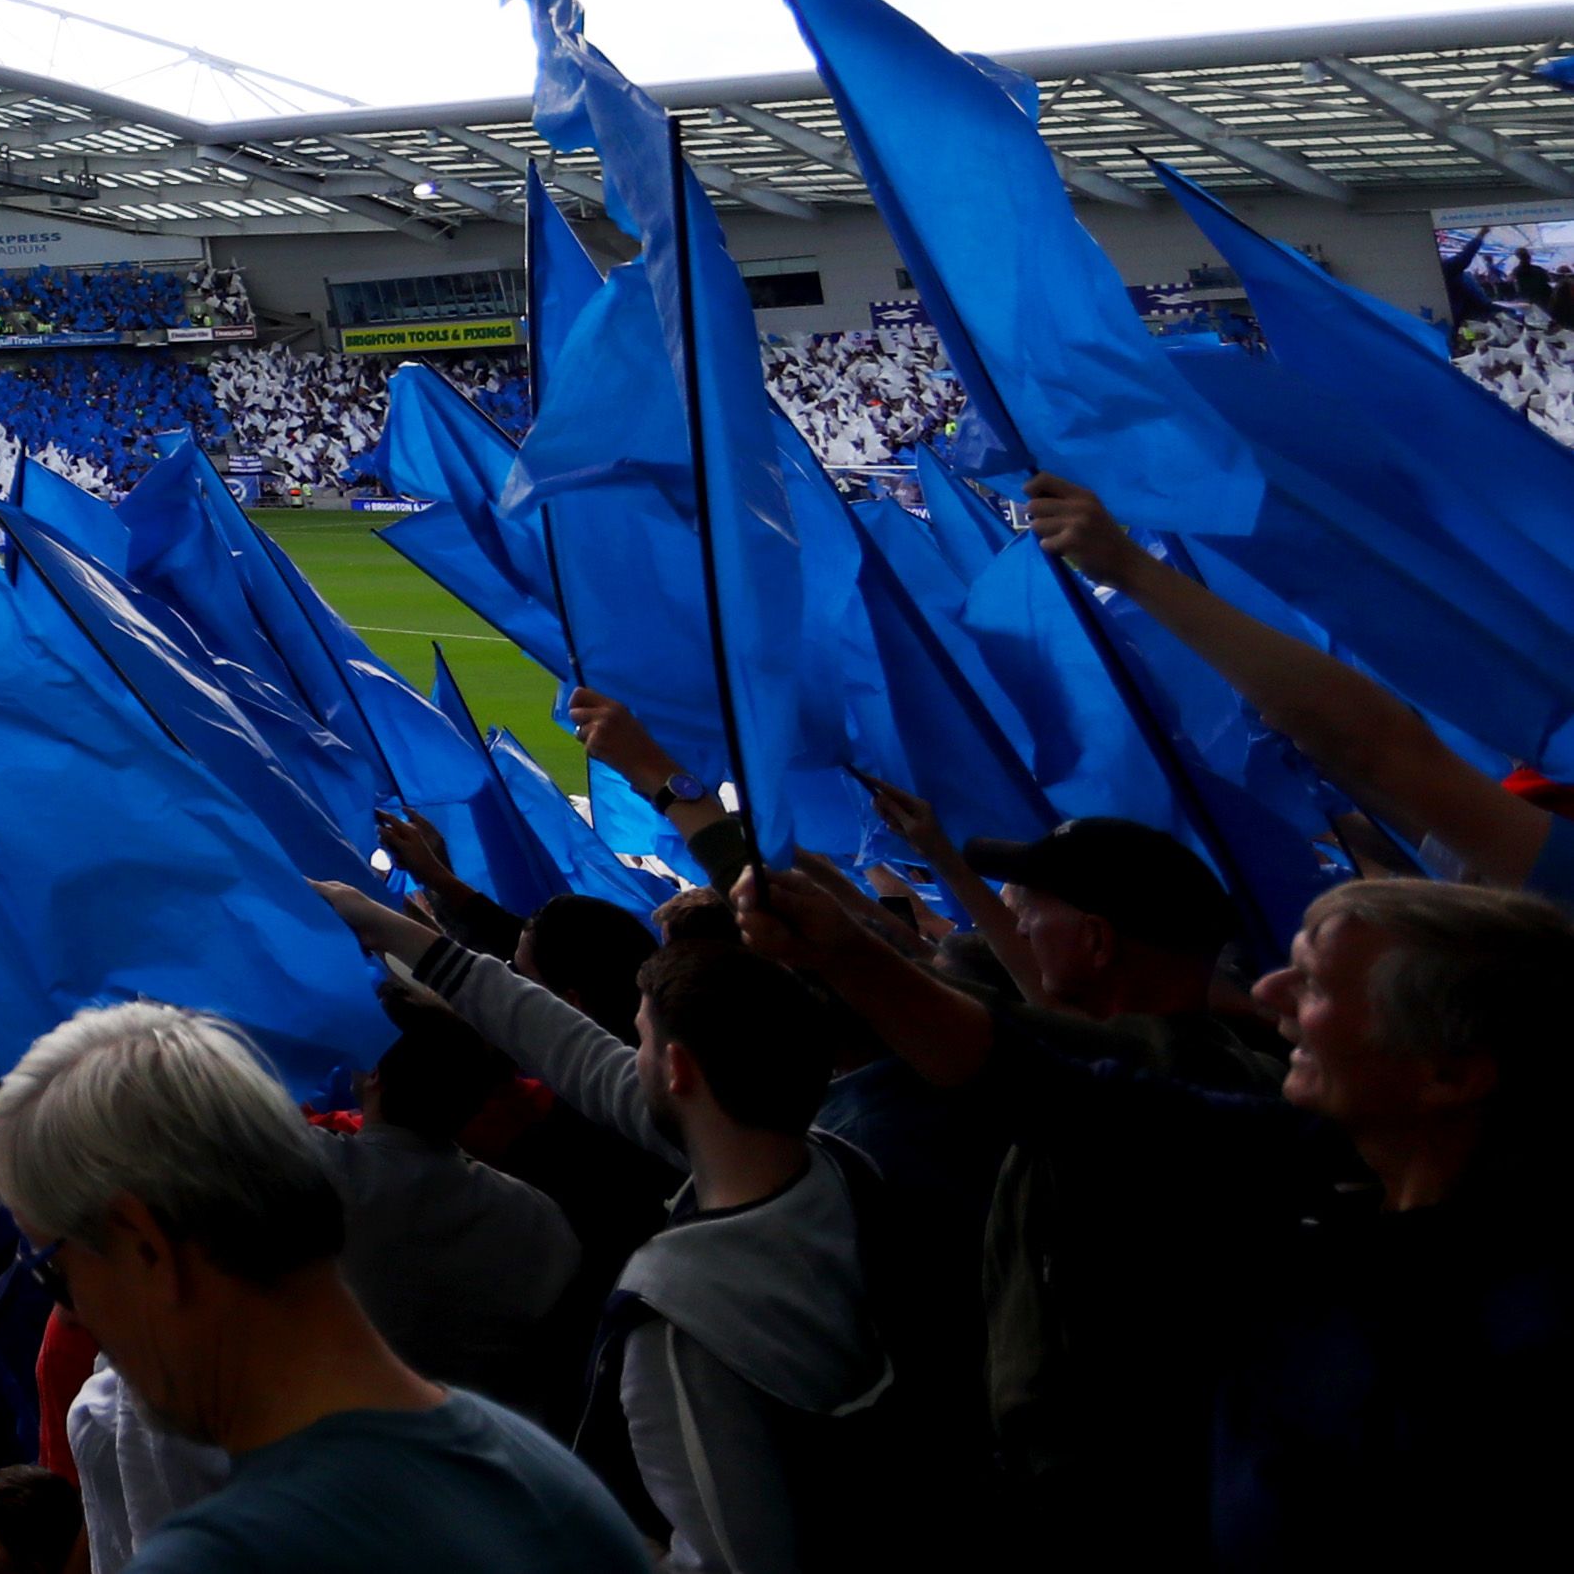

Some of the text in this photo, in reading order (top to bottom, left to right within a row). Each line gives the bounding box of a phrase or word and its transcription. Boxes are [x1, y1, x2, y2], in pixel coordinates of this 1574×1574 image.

[345, 325, 512, 347] BRIGHTON TOOLS & FIXINGS
[371, 502, 412, 512] BRIGHTON
